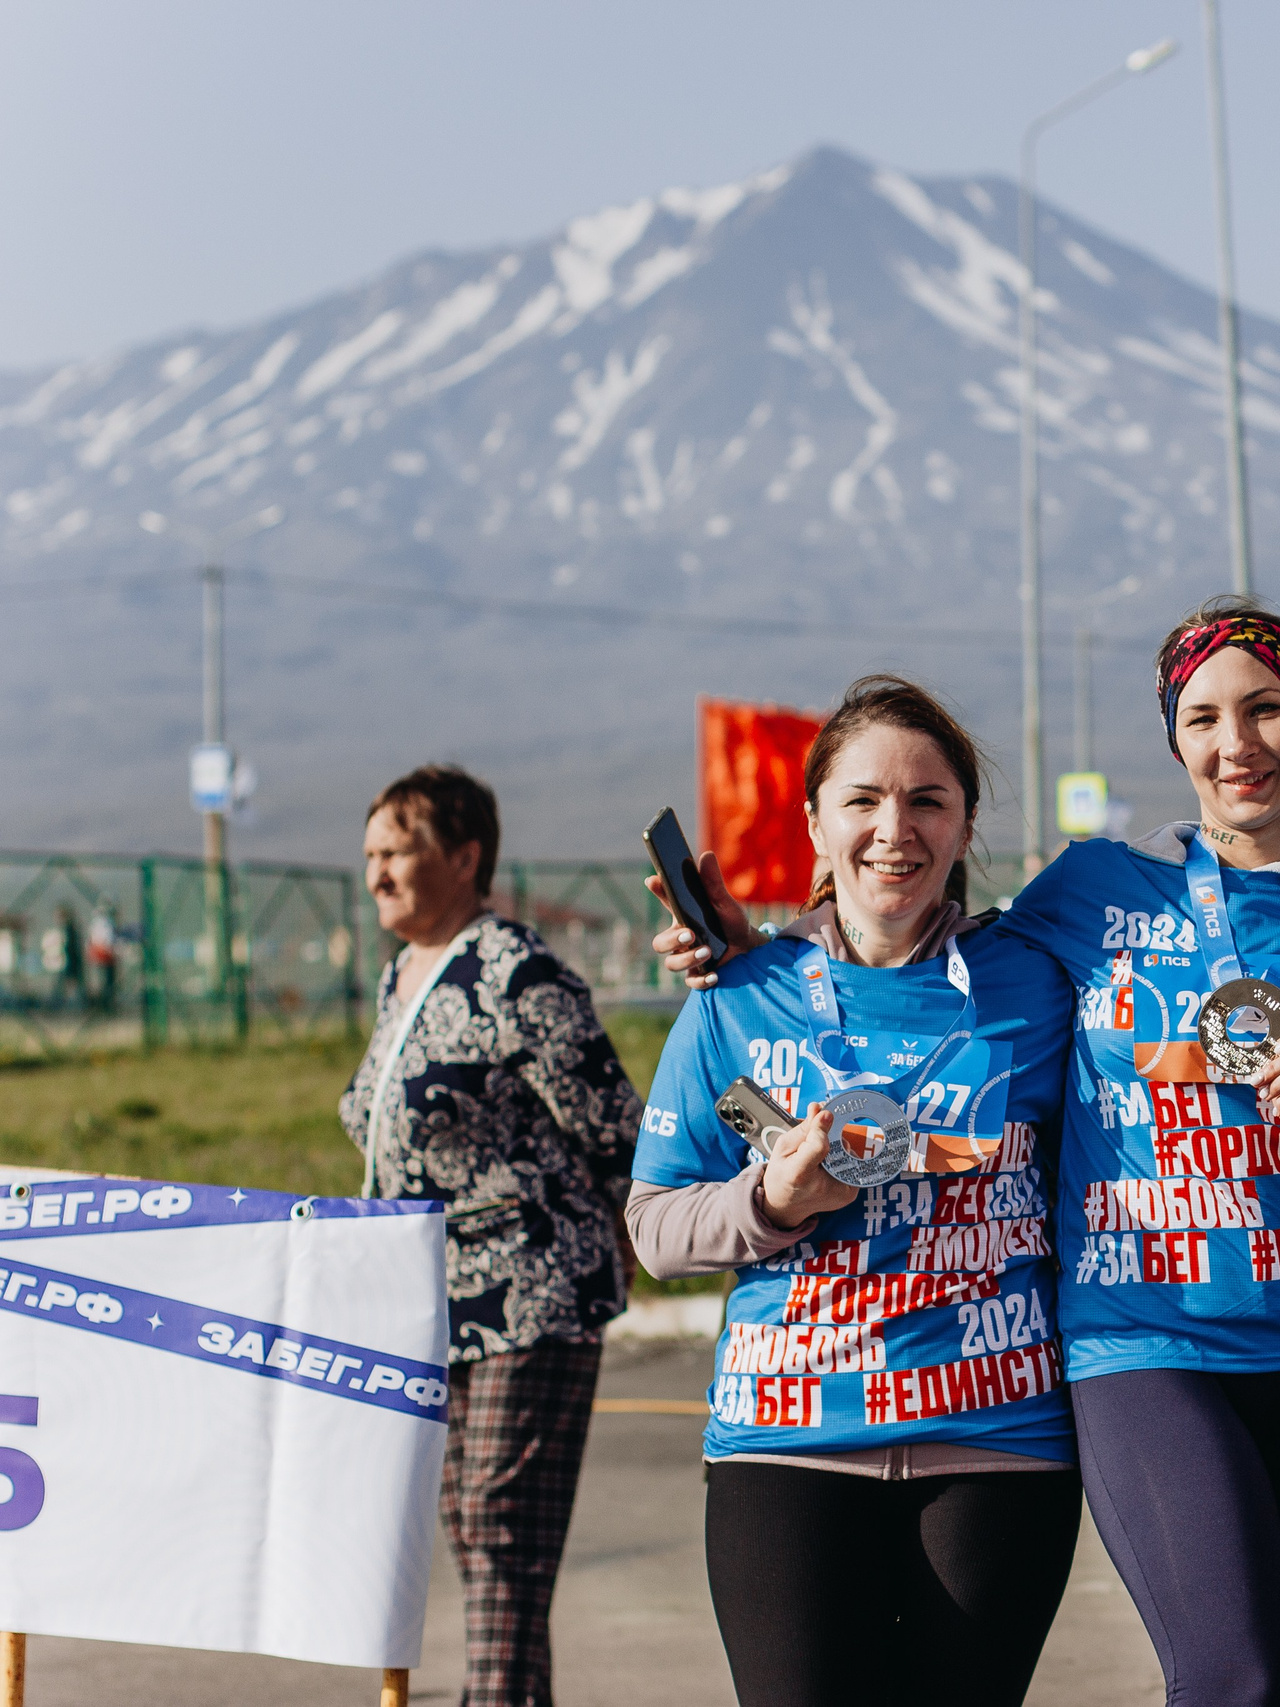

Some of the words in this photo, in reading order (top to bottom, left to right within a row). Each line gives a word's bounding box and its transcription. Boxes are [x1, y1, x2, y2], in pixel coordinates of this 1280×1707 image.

[1102, 906, 1199, 952] 2024
[1203, 908, 1221, 938] ПСБ
[1161, 956, 1191, 968] ПСБ
[809, 983, 827, 1012] ПСБ
[1084, 1178, 1265, 1233] #ЛЮБОВЬ
[1076, 1231, 1211, 1286] #ЗАБЕГ
[958, 1288, 1048, 1358] 2024
[198, 1321, 448, 1408] ЗАБЕГ.РФ
